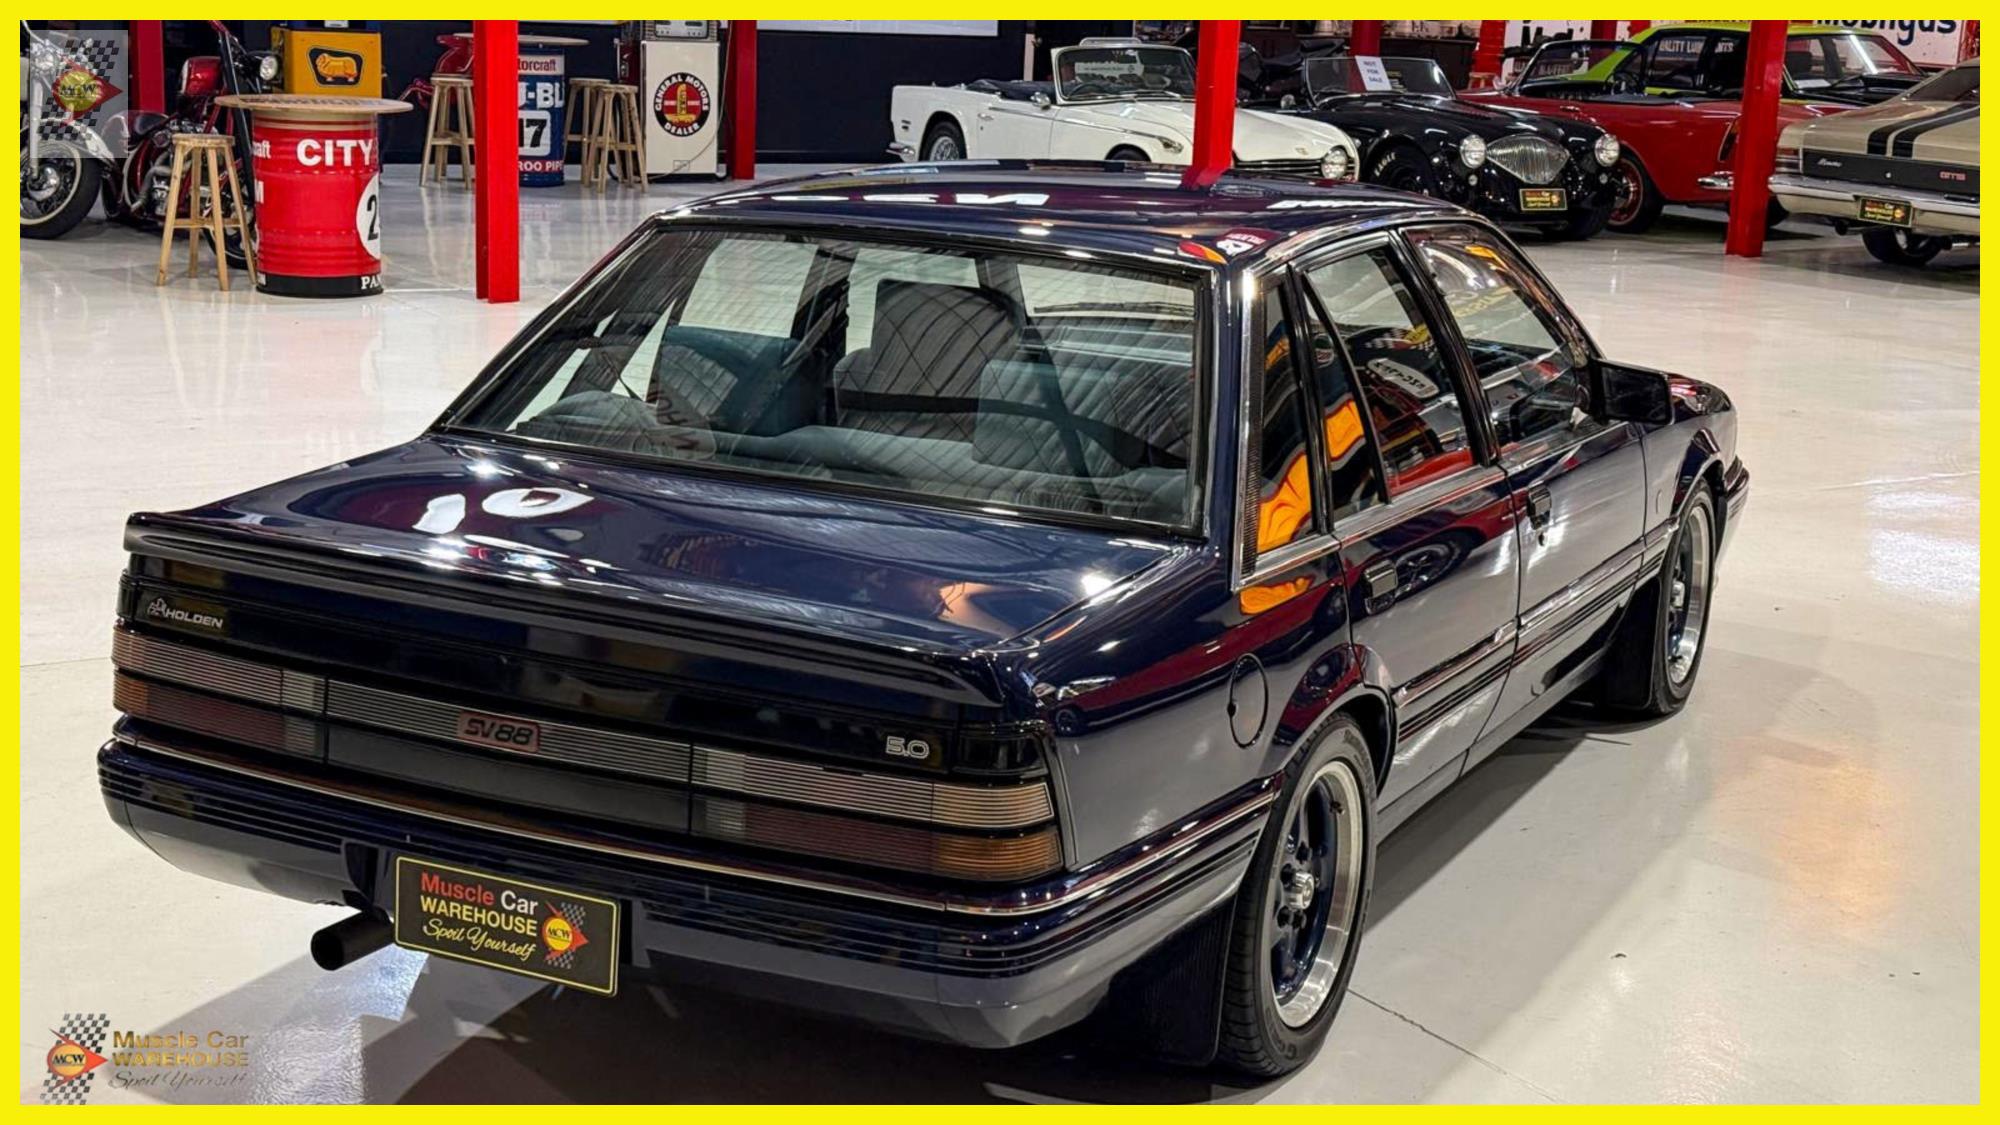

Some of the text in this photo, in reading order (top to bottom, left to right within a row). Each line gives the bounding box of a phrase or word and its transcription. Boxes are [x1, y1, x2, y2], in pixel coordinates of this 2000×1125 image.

[655, 74, 710, 111] GENERAL MOTORS
[664, 122, 700, 135] DEALER
[296, 138, 373, 167] CITY
[367, 194, 379, 241] 2
[164, 608, 223, 629] HOLDEN
[464, 718, 533, 745] SV88
[886, 736, 929, 759] 5.0
[420, 871, 539, 915] Muscle Car
[420, 895, 538, 937] WAREHOUSE
[423, 918, 537, 962] Spoil Yourself
